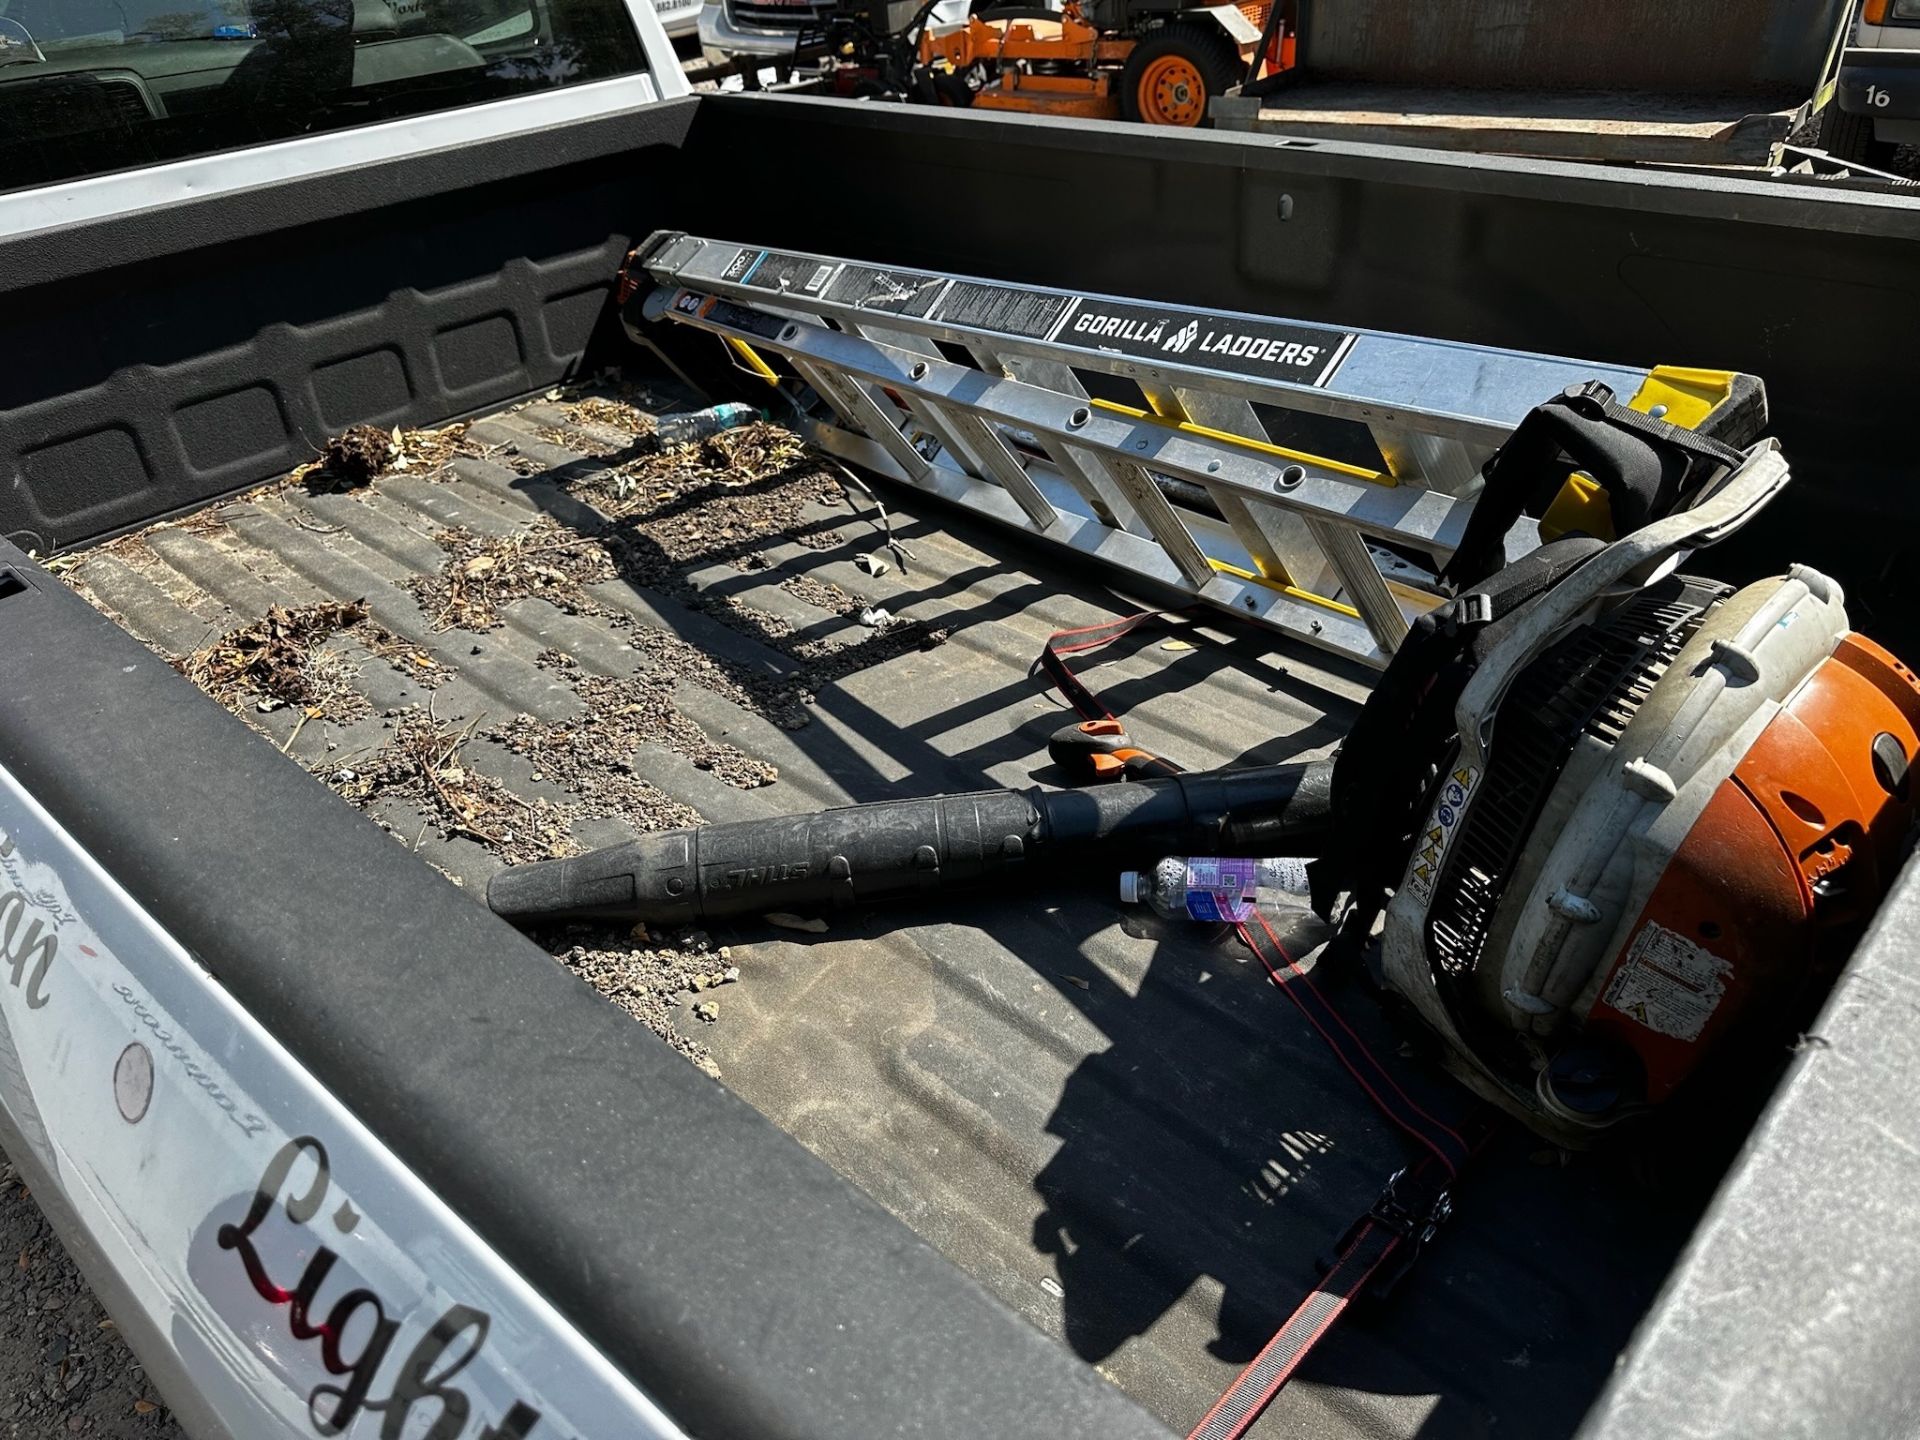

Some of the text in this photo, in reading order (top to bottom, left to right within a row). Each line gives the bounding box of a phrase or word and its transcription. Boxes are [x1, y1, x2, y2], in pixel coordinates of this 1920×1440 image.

[1866, 85, 1890, 107] 16
[1073, 313, 1319, 367] GORILLA LADDERS
